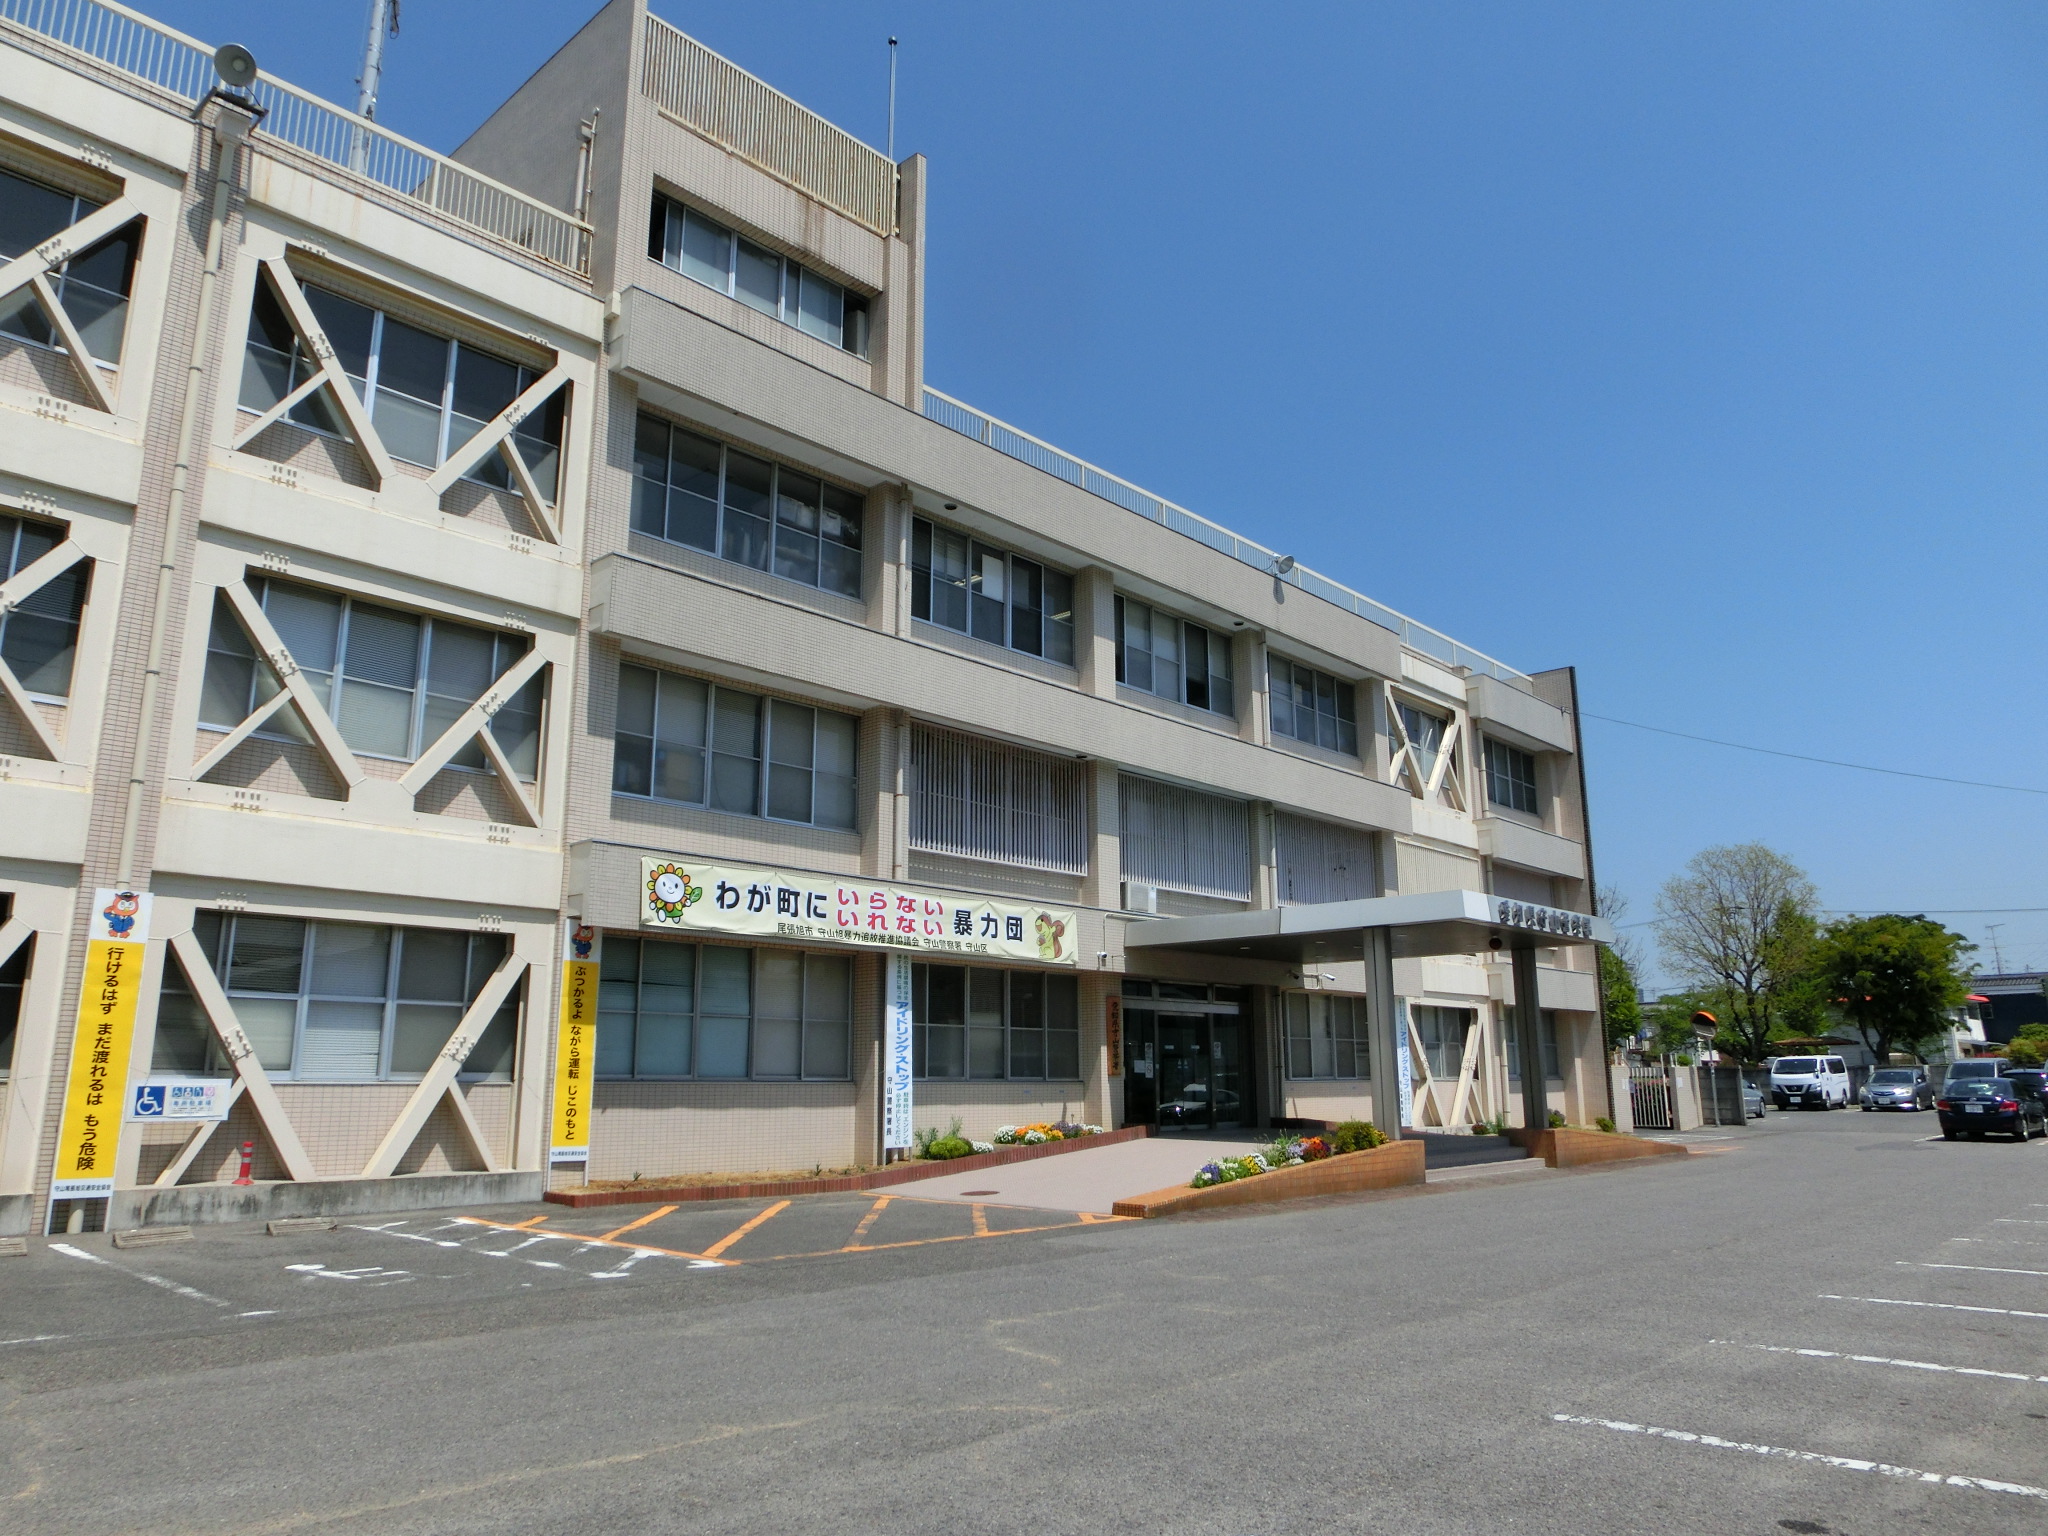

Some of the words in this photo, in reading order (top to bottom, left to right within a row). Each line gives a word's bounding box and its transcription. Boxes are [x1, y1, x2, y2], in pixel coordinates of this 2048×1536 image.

[716, 880, 828, 920] わが町に
[837, 887, 944, 917] いらない
[953, 911, 1024, 943] 暴力団
[777, 922, 813, 936] 尾張旭市
[924, 939, 961, 951] 守山警察署
[965, 943, 988, 953] 守山区
[837, 908, 944, 935] いれない
[99, 946, 125, 1015] 行けるはず
[571, 966, 587, 1020] ぶつかるよ
[86, 1022, 113, 1106] まだ渡れるは
[567, 1025, 582, 1080] ながら運転
[565, 1085, 578, 1141] じこのもと
[76, 1113, 100, 1171] もう危険
